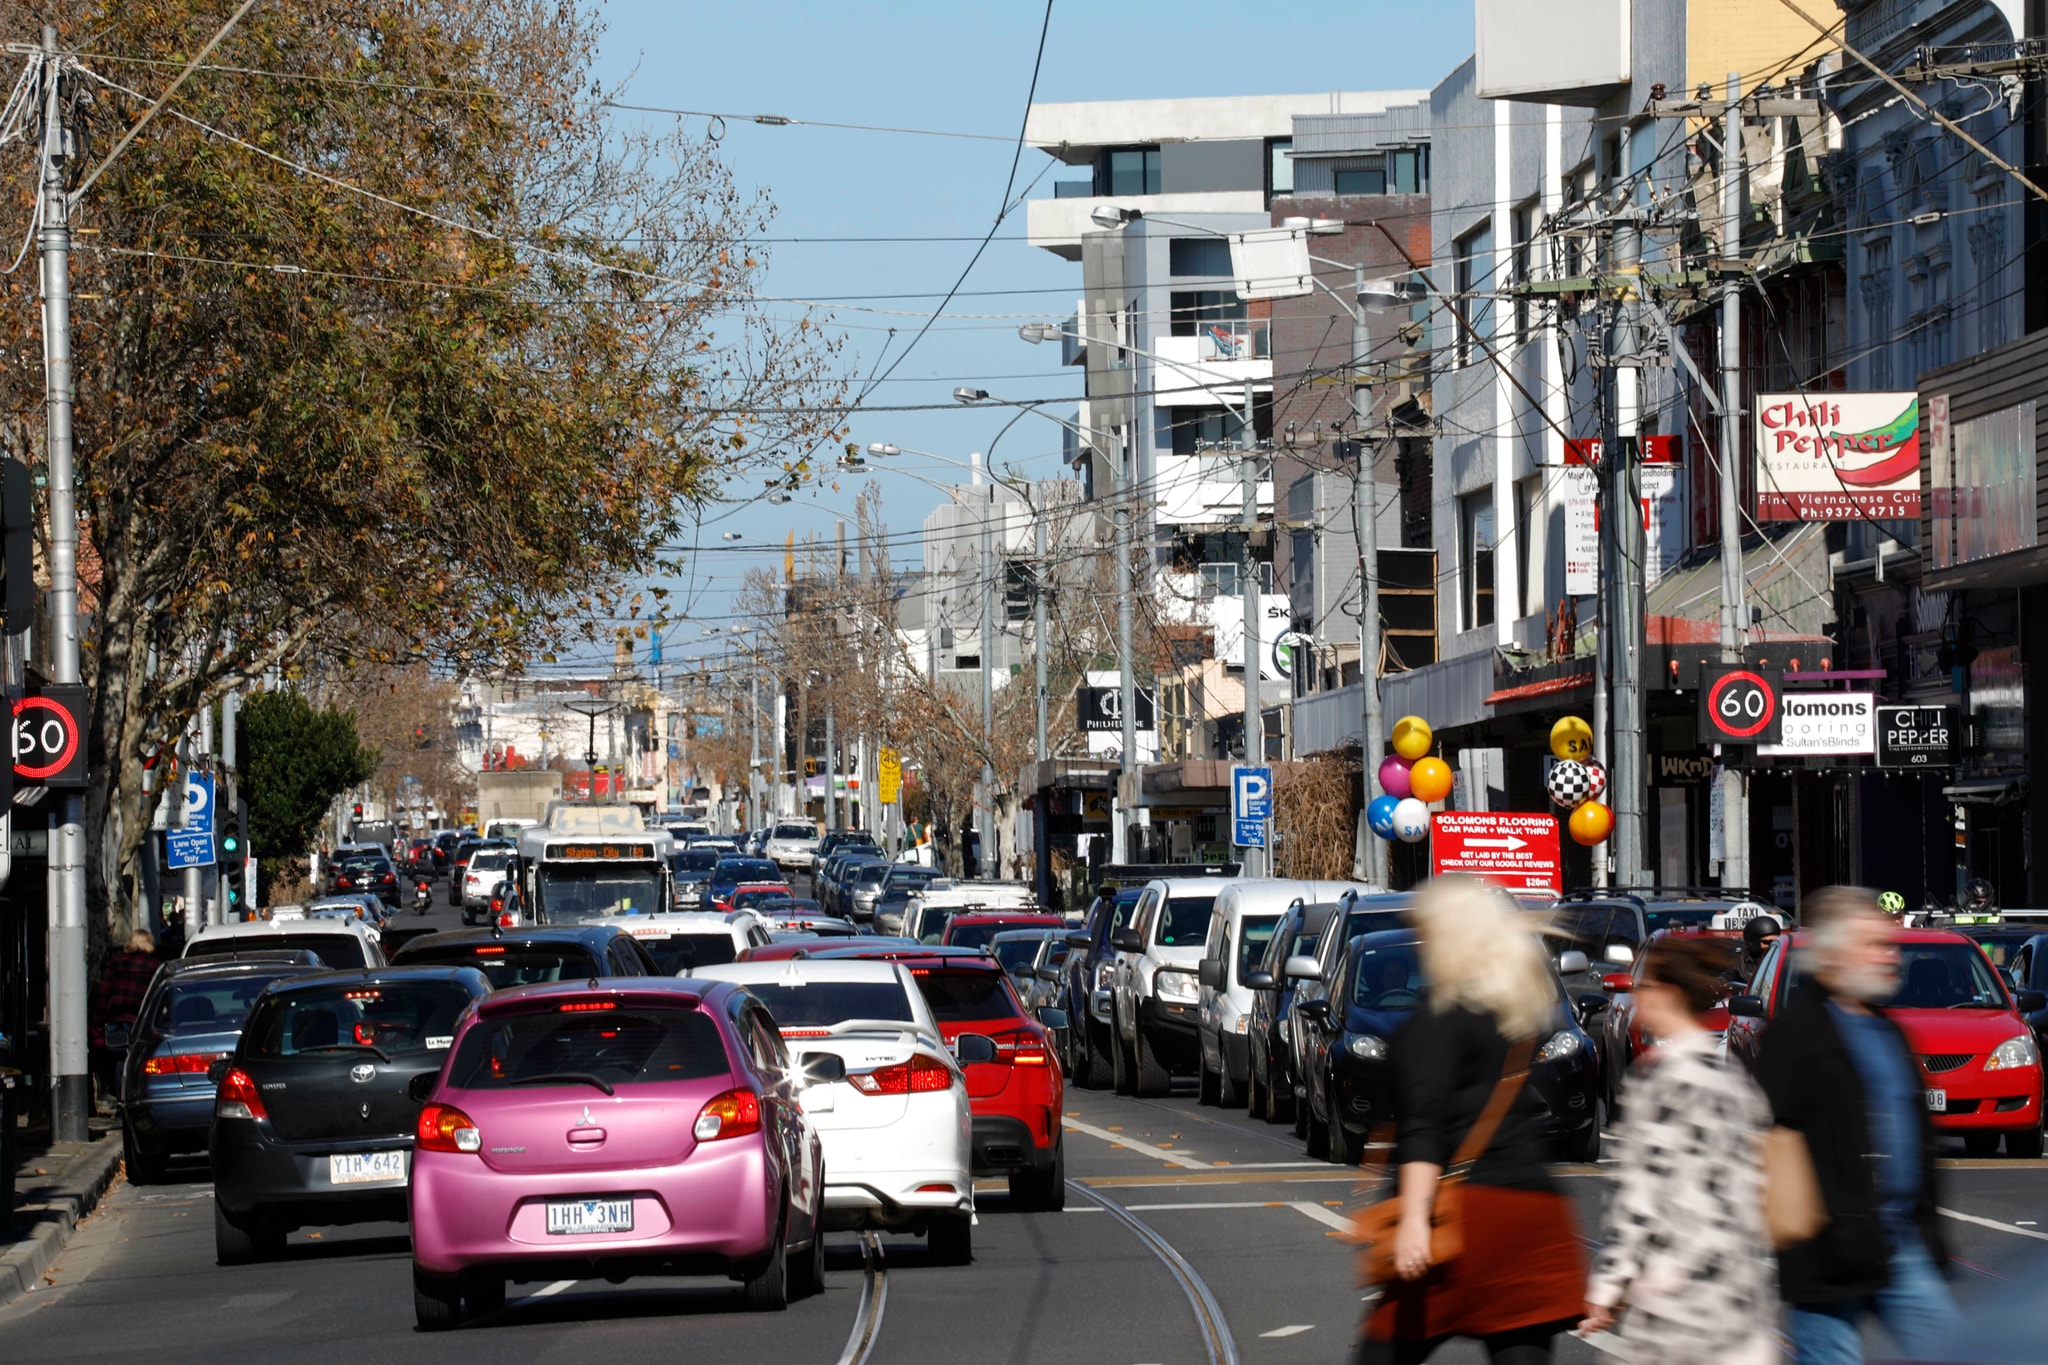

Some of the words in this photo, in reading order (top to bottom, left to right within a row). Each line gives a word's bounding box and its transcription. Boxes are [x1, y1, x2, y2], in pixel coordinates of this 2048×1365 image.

[1761, 400, 1840, 428] Chili
[1773, 430, 1893, 459] Pepper
[1641, 469, 1676, 478] andholding
[1759, 494, 1788, 505] Fine
[1798, 494, 1884, 504] Vietnamese
[1800, 507, 1862, 518] Ph:9375
[1868, 506, 1905, 516] 4715
[1721, 689, 1764, 718] 60
[1781, 700, 1866, 716] lomons
[1895, 711, 1941, 728] CHILI
[1784, 721, 1866, 736] ooring
[1887, 730, 1948, 744] PEPPER
[1911, 754, 1927, 763] 603
[1240, 776, 1267, 818] P
[1436, 816, 1496, 825] SOLOMONS
[1499, 817, 1554, 827] FLOORING
[11, 837, 37, 849] AL
[190, 839, 207, 848] Open
[184, 855, 199, 863] Only
[566, 848, 596, 858] Station
[603, 848, 619, 858] City
[1737, 908, 1758, 918] TAXI
[335, 1158, 361, 1173] YIH
[374, 1155, 400, 1170] 642
[552, 1206, 582, 1225] 1HH
[598, 1204, 629, 1223] 3NH
